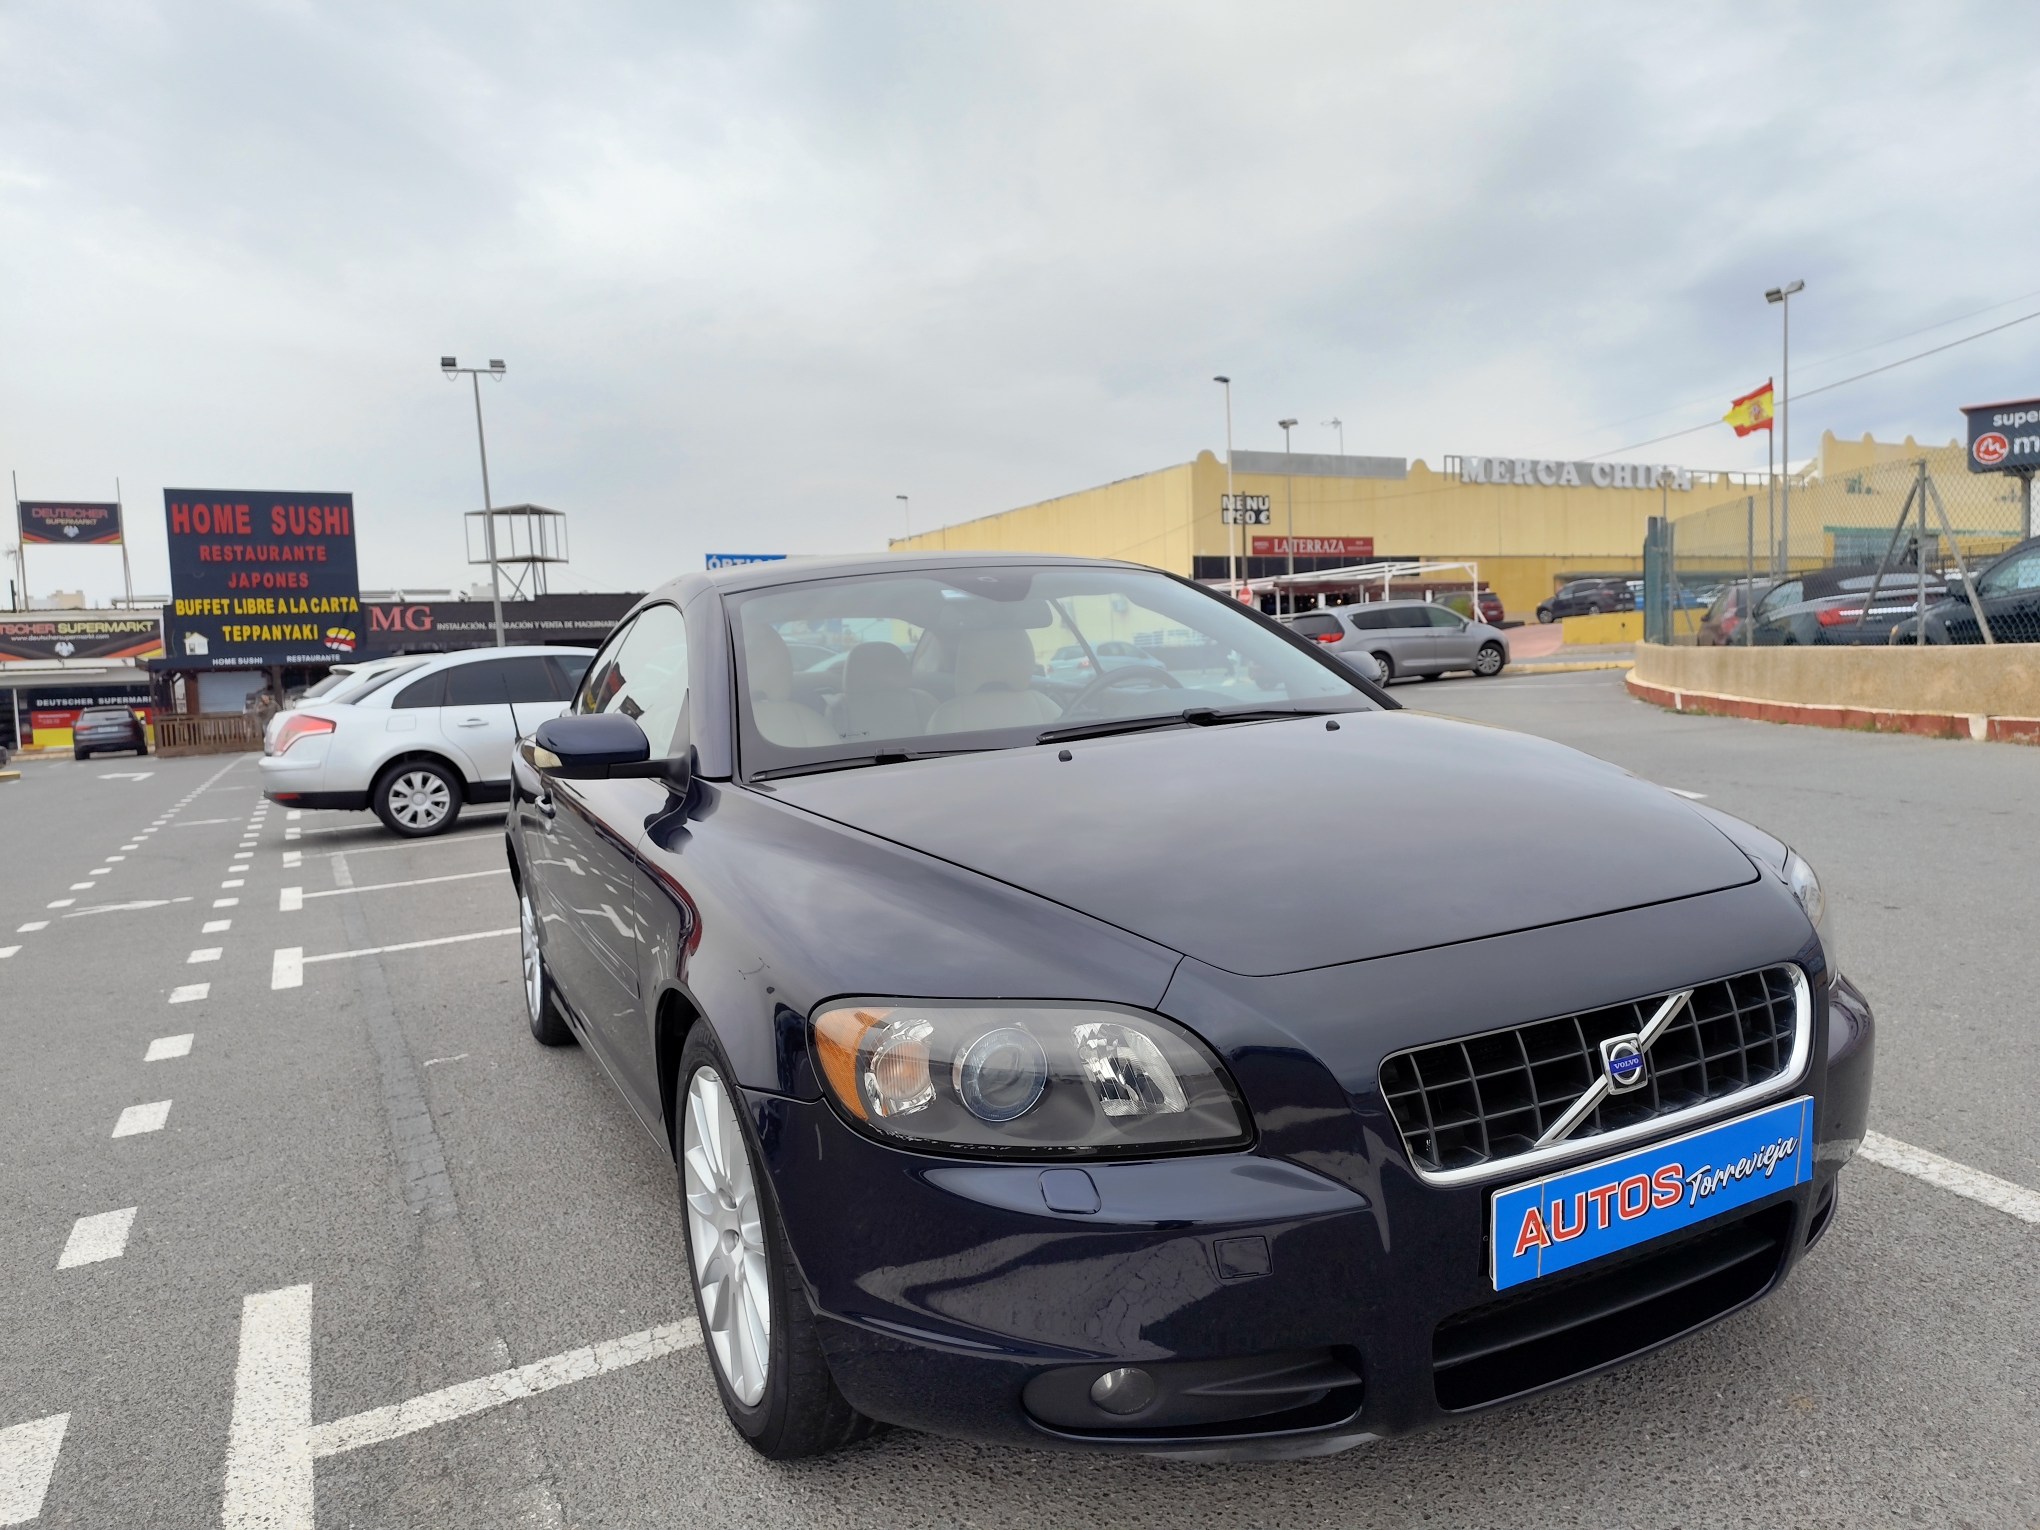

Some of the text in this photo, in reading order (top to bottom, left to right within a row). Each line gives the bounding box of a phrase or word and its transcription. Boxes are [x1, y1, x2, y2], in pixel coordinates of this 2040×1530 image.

[1461, 456, 1581, 486] MERCA
[31, 508, 108, 518] DEUTSCHER
[171, 503, 350, 536] HOME SUSHI
[1259, 511, 1270, 524] €
[45, 518, 97, 526] SUPERMARKT
[199, 545, 328, 562] RESTAURANTE
[1273, 539, 1290, 553] LA
[1292, 539, 1346, 554] TERRAZA
[228, 572, 309, 589] JAPONES
[175, 596, 359, 616] BUFFET LIBRE A LA CARTA
[368, 606, 434, 632] MG
[488, 620, 534, 631] REARACIÓN
[534, 621, 541, 630] Y
[540, 620, 563, 629] VENTA
[564, 620, 574, 629] DE
[57, 621, 154, 634] SUPERMARKT
[222, 624, 319, 642] TEPPANYAKI
[212, 654, 341, 666] HOME SUSHI RESTAURANTE
[36, 698, 93, 707] DEUTSCHER
[1614, 1058, 1639, 1069] VOLVO
[1512, 1135, 1798, 1258] AUTOS Torrevieja
